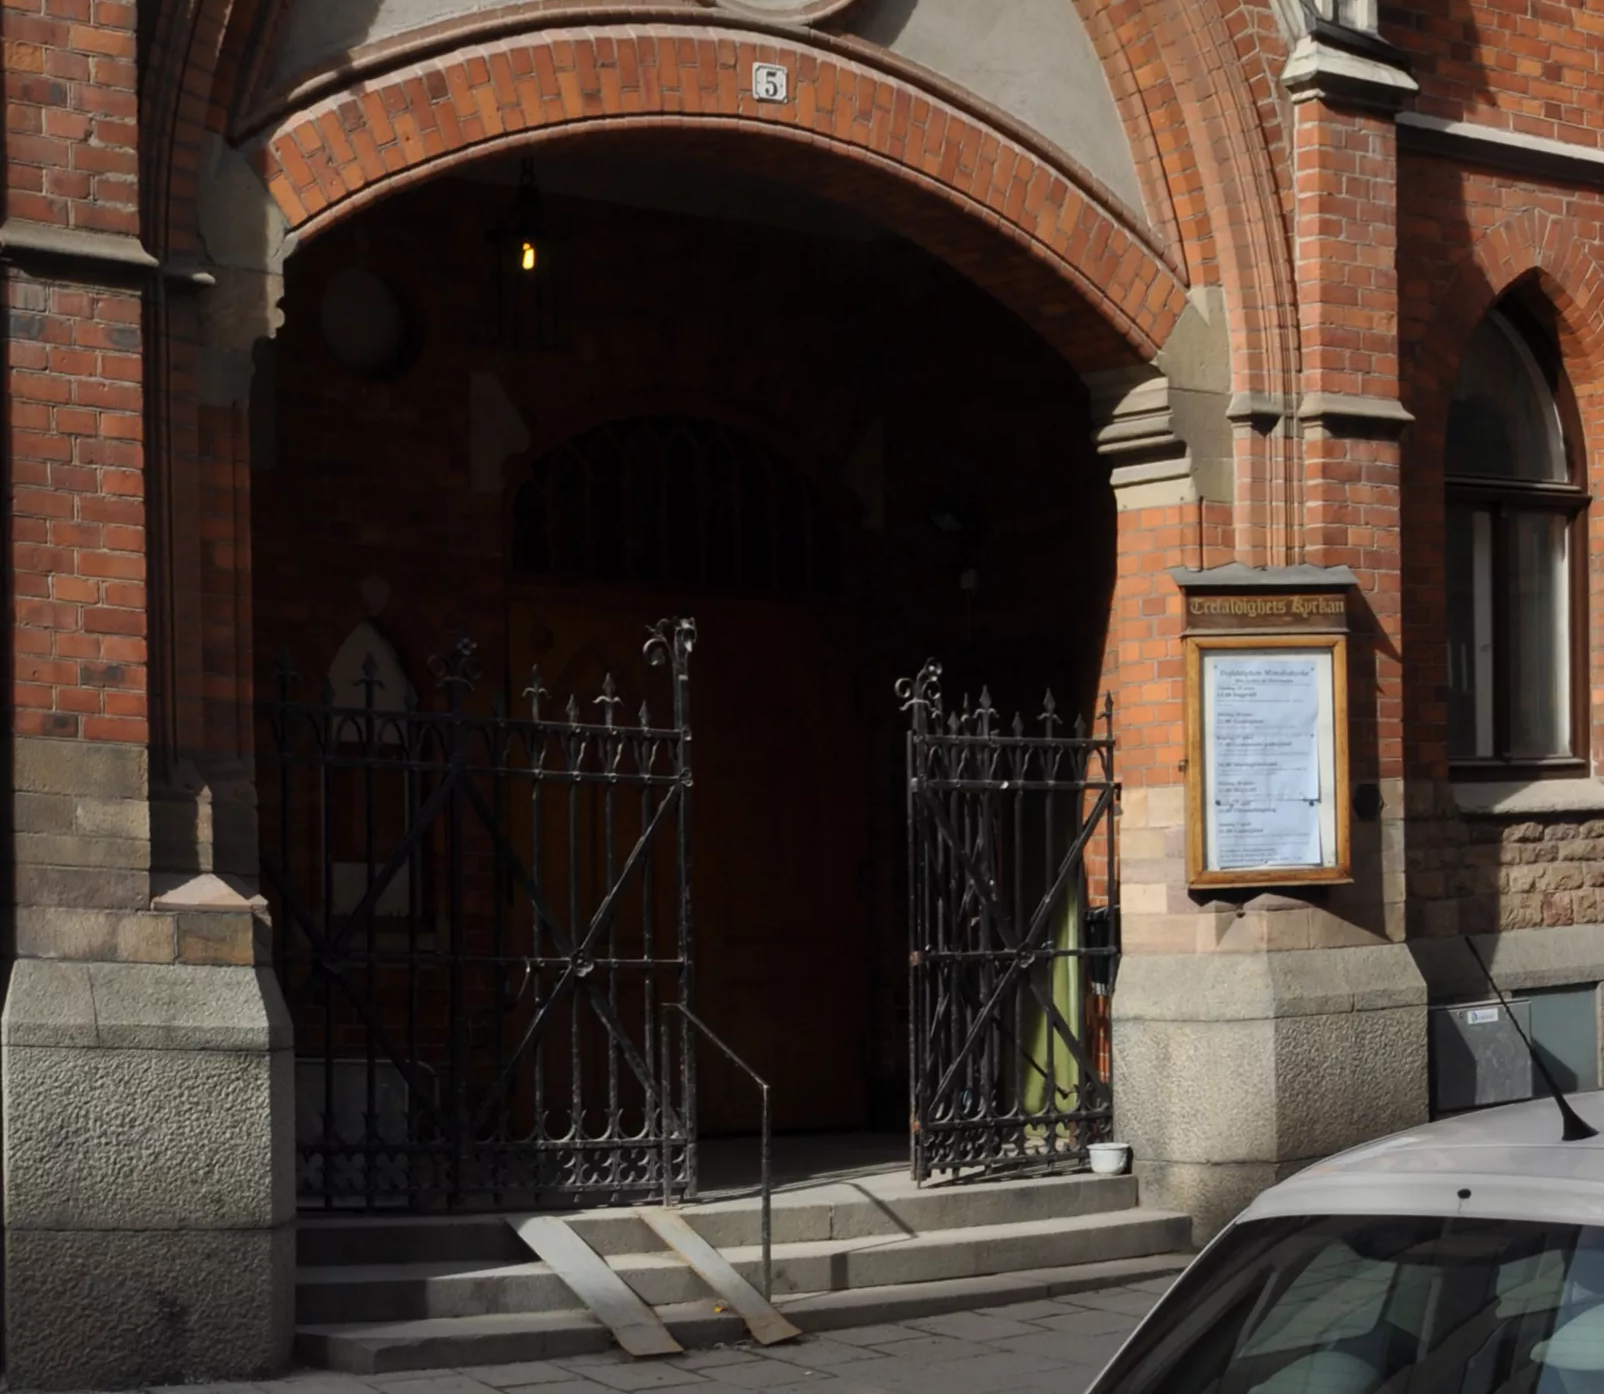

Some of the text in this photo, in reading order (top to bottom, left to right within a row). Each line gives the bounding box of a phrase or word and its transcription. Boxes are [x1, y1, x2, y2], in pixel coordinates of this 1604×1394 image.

[765, 71, 778, 97] 5
[1189, 595, 1345, 619] Trefaldighets Kyrkan
